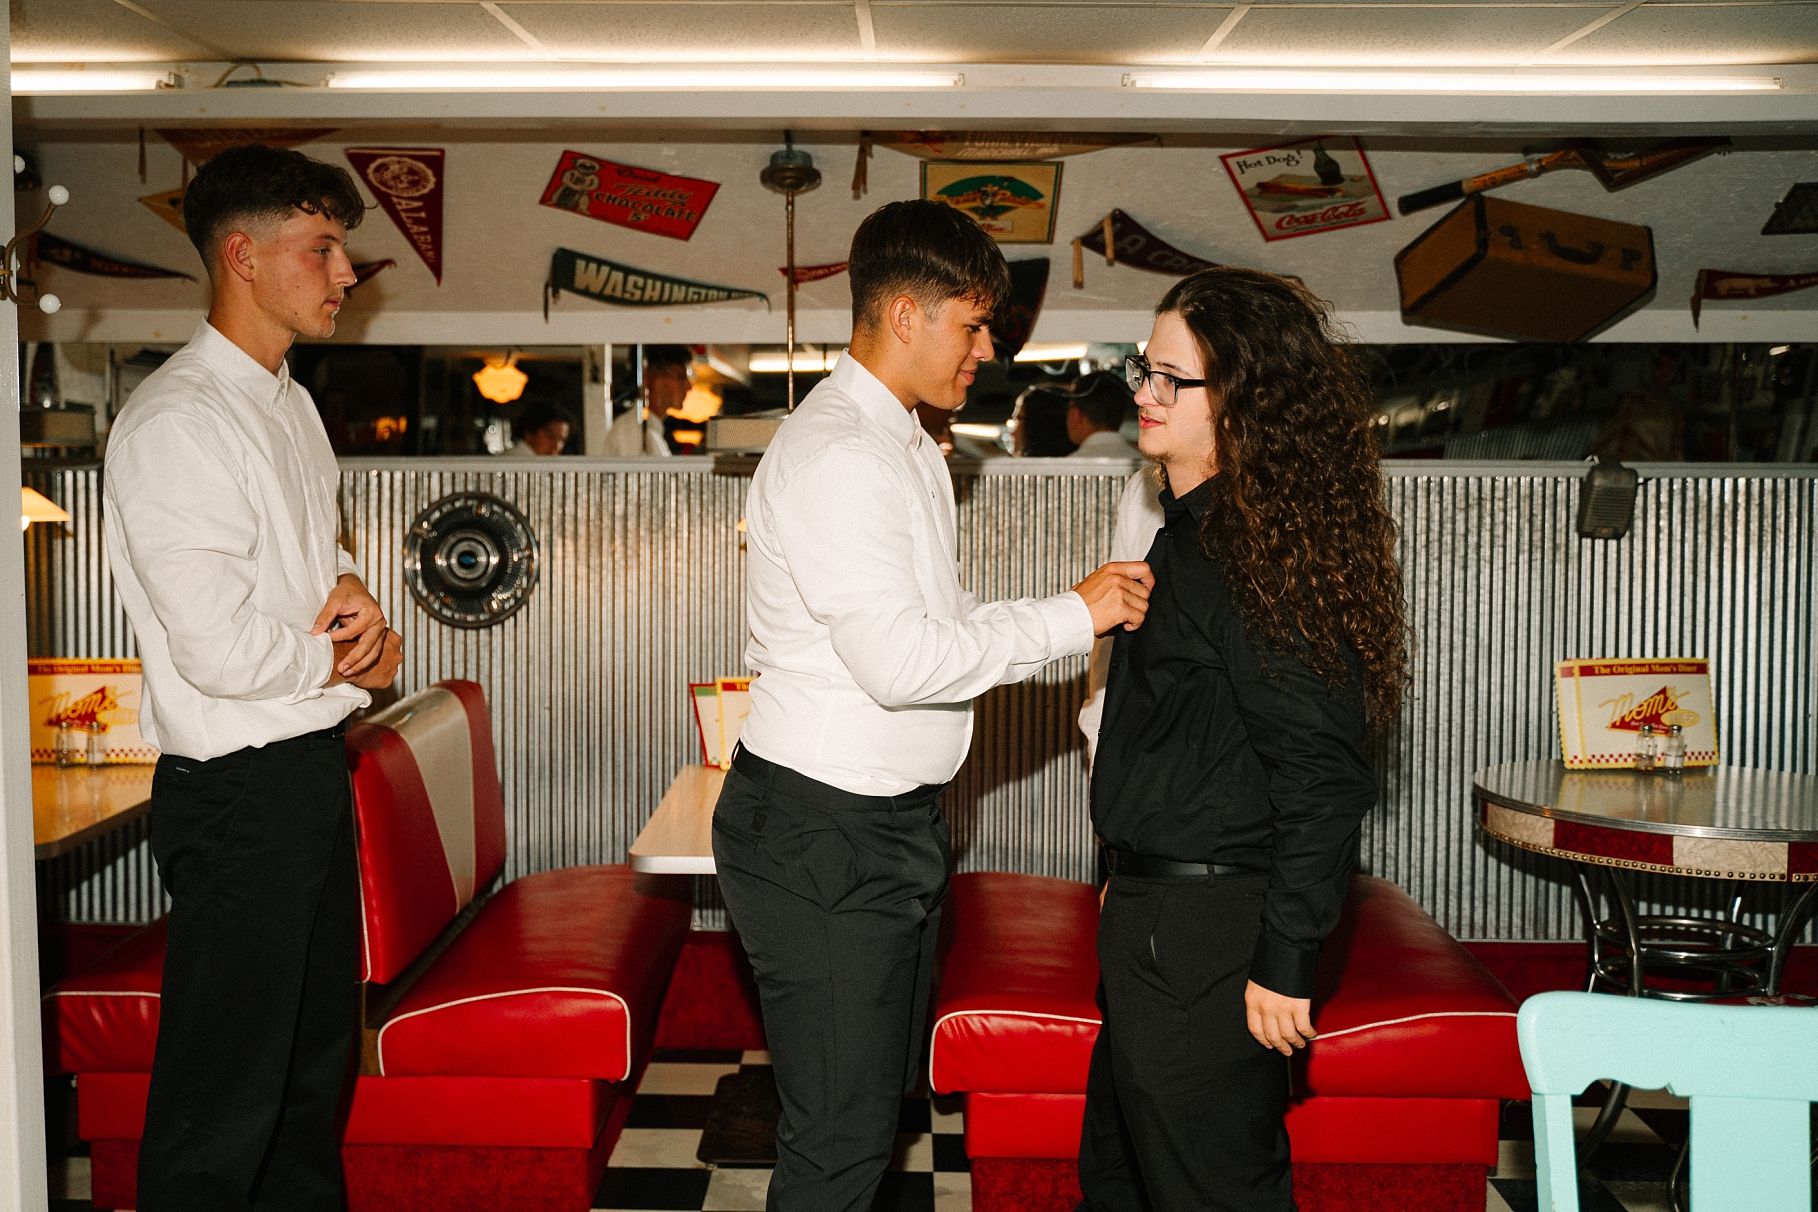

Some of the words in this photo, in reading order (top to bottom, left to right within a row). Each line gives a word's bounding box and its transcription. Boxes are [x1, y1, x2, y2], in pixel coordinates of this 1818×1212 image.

[1236, 160, 1264, 175] Hot
[1266, 149, 1304, 168] Dog!
[594, 191, 697, 222] CHOCOLATE
[1275, 200, 1367, 231] Coca-Cola
[573, 258, 728, 303] WASHINGTON
[1594, 666, 1610, 674] The
[1612, 665, 1649, 675] Original
[1651, 664, 1677, 673] Mom's
[1678, 664, 1698, 673] Diner
